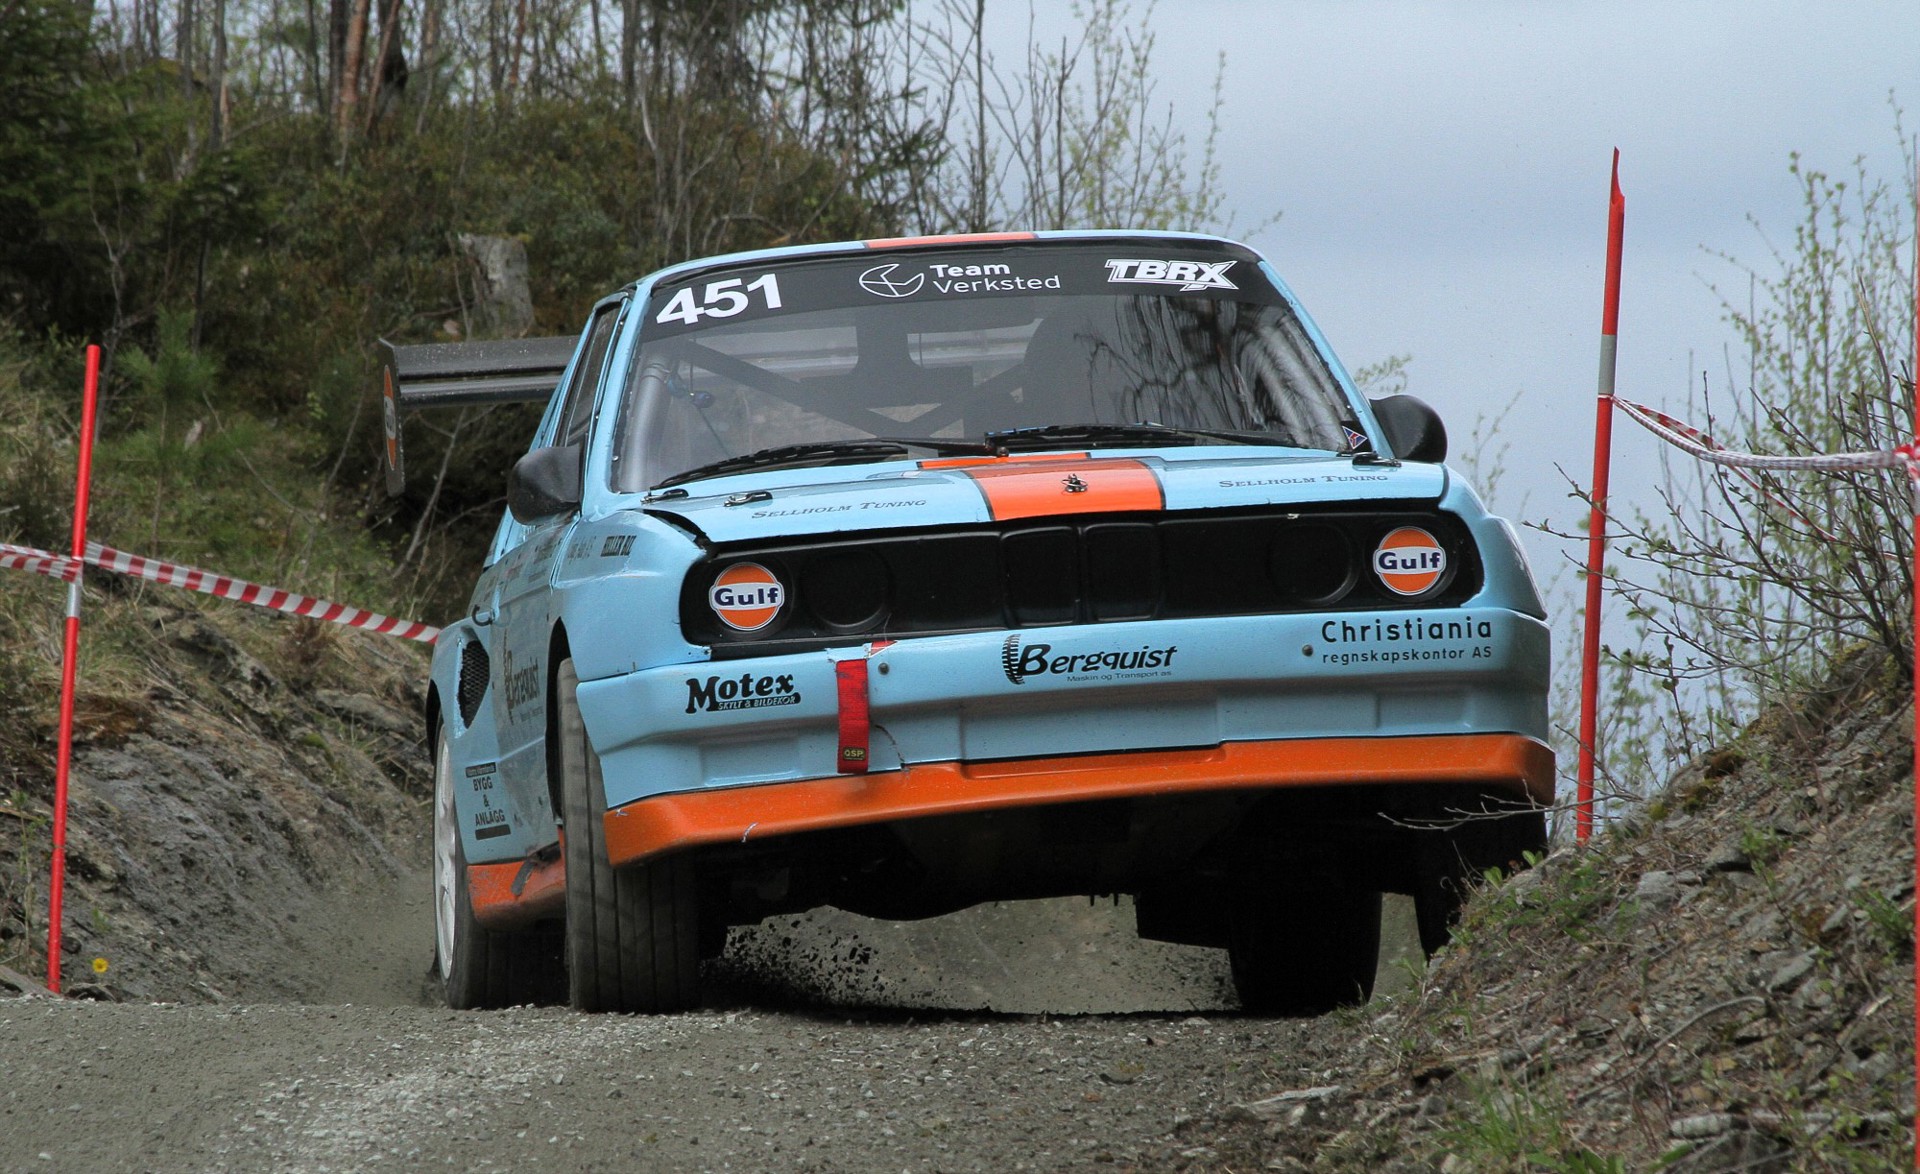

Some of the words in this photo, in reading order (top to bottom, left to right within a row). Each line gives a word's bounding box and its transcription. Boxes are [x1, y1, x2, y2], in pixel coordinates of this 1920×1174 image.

[930, 263, 1011, 279] Team
[1105, 258, 1239, 291] TBRX
[933, 275, 1061, 294] Verksted
[656, 273, 782, 325] 451
[1378, 552, 1441, 569] Gulf
[714, 587, 778, 606] Gulf
[1322, 616, 1491, 643] Christiania
[1017, 643, 1178, 676] Bergquist
[1322, 648, 1464, 665] regnskapskontor
[1472, 646, 1492, 658] AS
[1101, 674, 1112, 682] og
[1116, 671, 1158, 680] Transport
[685, 673, 794, 714] Motex
[718, 700, 743, 711] SKYLT
[744, 699, 753, 708] &
[754, 696, 796, 707] BILDEKOR
[844, 749, 864, 758] QSP
[473, 776, 493, 791] BYGG
[483, 794, 490, 807] &
